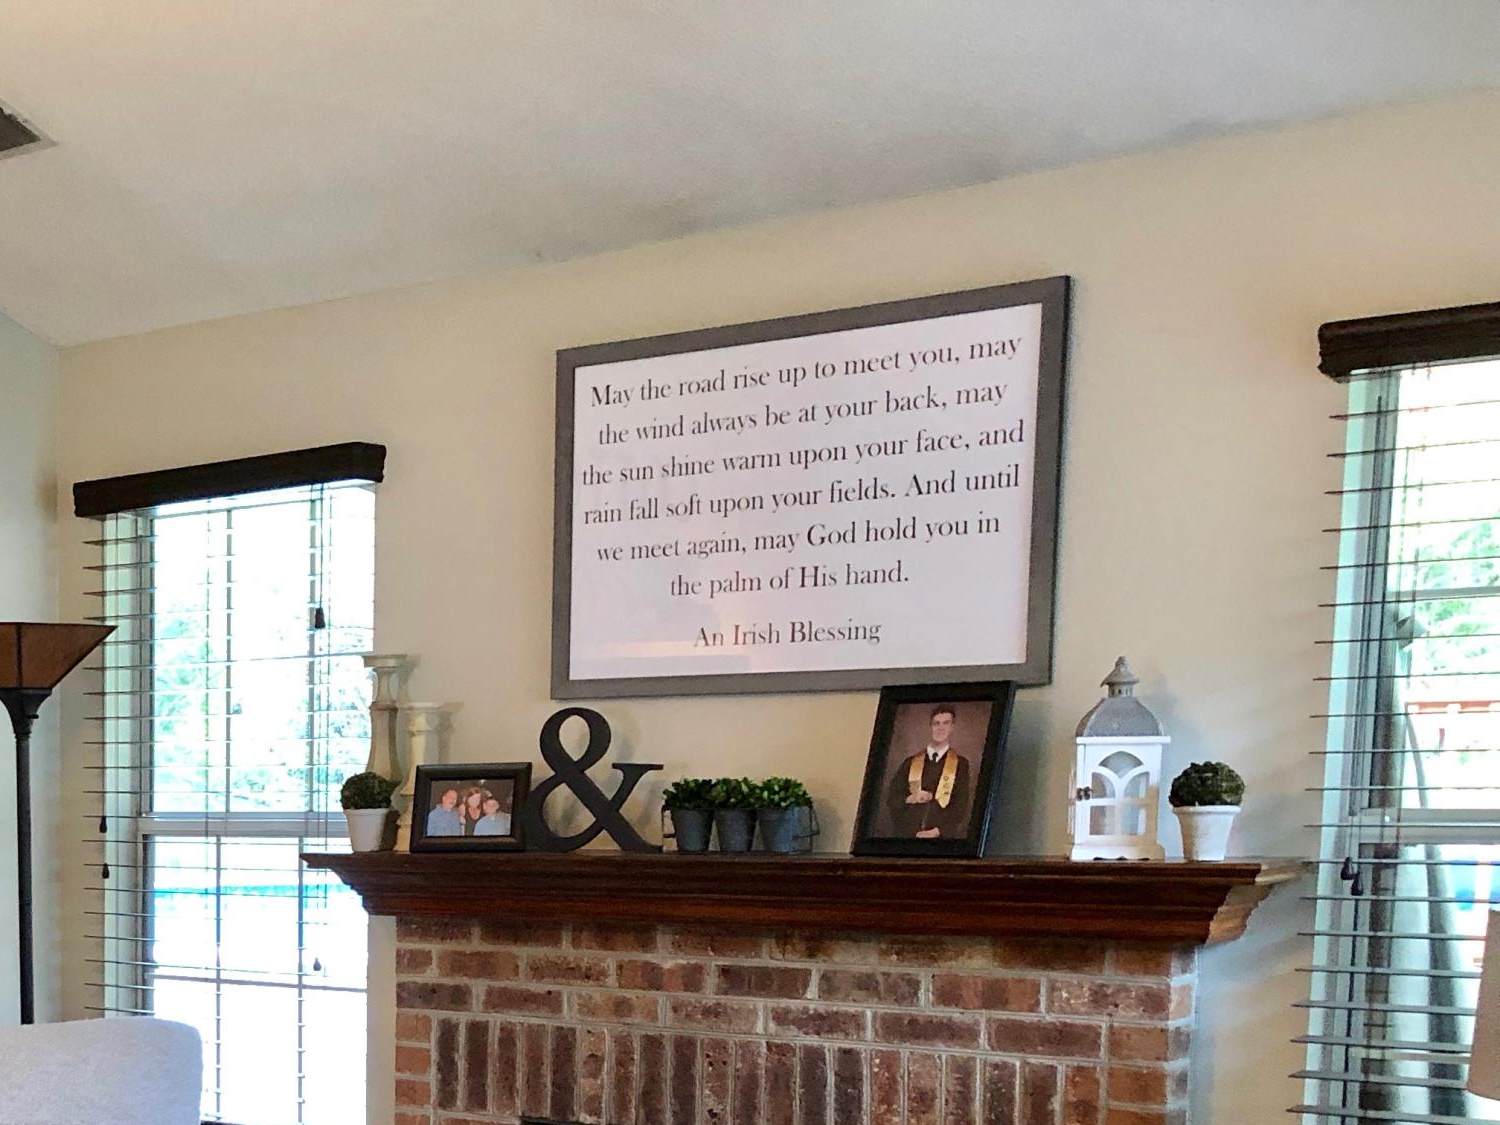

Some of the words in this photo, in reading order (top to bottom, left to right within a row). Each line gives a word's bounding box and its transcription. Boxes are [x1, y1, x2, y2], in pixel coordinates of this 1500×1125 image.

[590, 384, 634, 408] May
[640, 378, 672, 401] the
[678, 368, 726, 397] road
[733, 366, 771, 390] rise
[778, 366, 807, 388] up
[814, 361, 837, 380] to
[844, 351, 900, 376] meet
[909, 347, 960, 373] you,
[969, 337, 1021, 361] may
[599, 423, 629, 446] the
[635, 414, 684, 440] wind
[691, 411, 758, 435] always
[765, 404, 791, 427] be
[798, 404, 816, 423] at
[824, 399, 878, 426] your
[885, 384, 947, 413] back,
[956, 384, 1007, 407] may
[582, 464, 613, 486] the
[619, 465, 654, 482] sun
[661, 454, 715, 478] shine
[722, 452, 781, 471] warm
[789, 446, 847, 470] upon
[855, 439, 909, 465] your
[916, 428, 970, 453] face,
[978, 418, 1024, 447] and
[584, 501, 622, 525] rain
[629, 497, 659, 521] fall
[665, 493, 701, 518] soft
[709, 495, 764, 519] upon
[771, 489, 823, 514] your
[829, 476, 896, 504] fields.
[904, 469, 956, 497] And
[965, 463, 1020, 492] until
[597, 547, 624, 561] we
[630, 540, 680, 560] meet
[686, 531, 747, 559] again,
[754, 533, 800, 554] may
[806, 520, 856, 547] God
[864, 515, 917, 543] hold
[925, 520, 969, 544] you
[978, 510, 1000, 534] in
[670, 574, 702, 596] the
[709, 570, 762, 600] palm
[769, 566, 795, 590] of
[799, 564, 838, 589] His
[845, 559, 909, 586] hand.
[693, 627, 724, 647] An
[733, 622, 780, 646] Irish
[789, 618, 882, 644] Blessing
